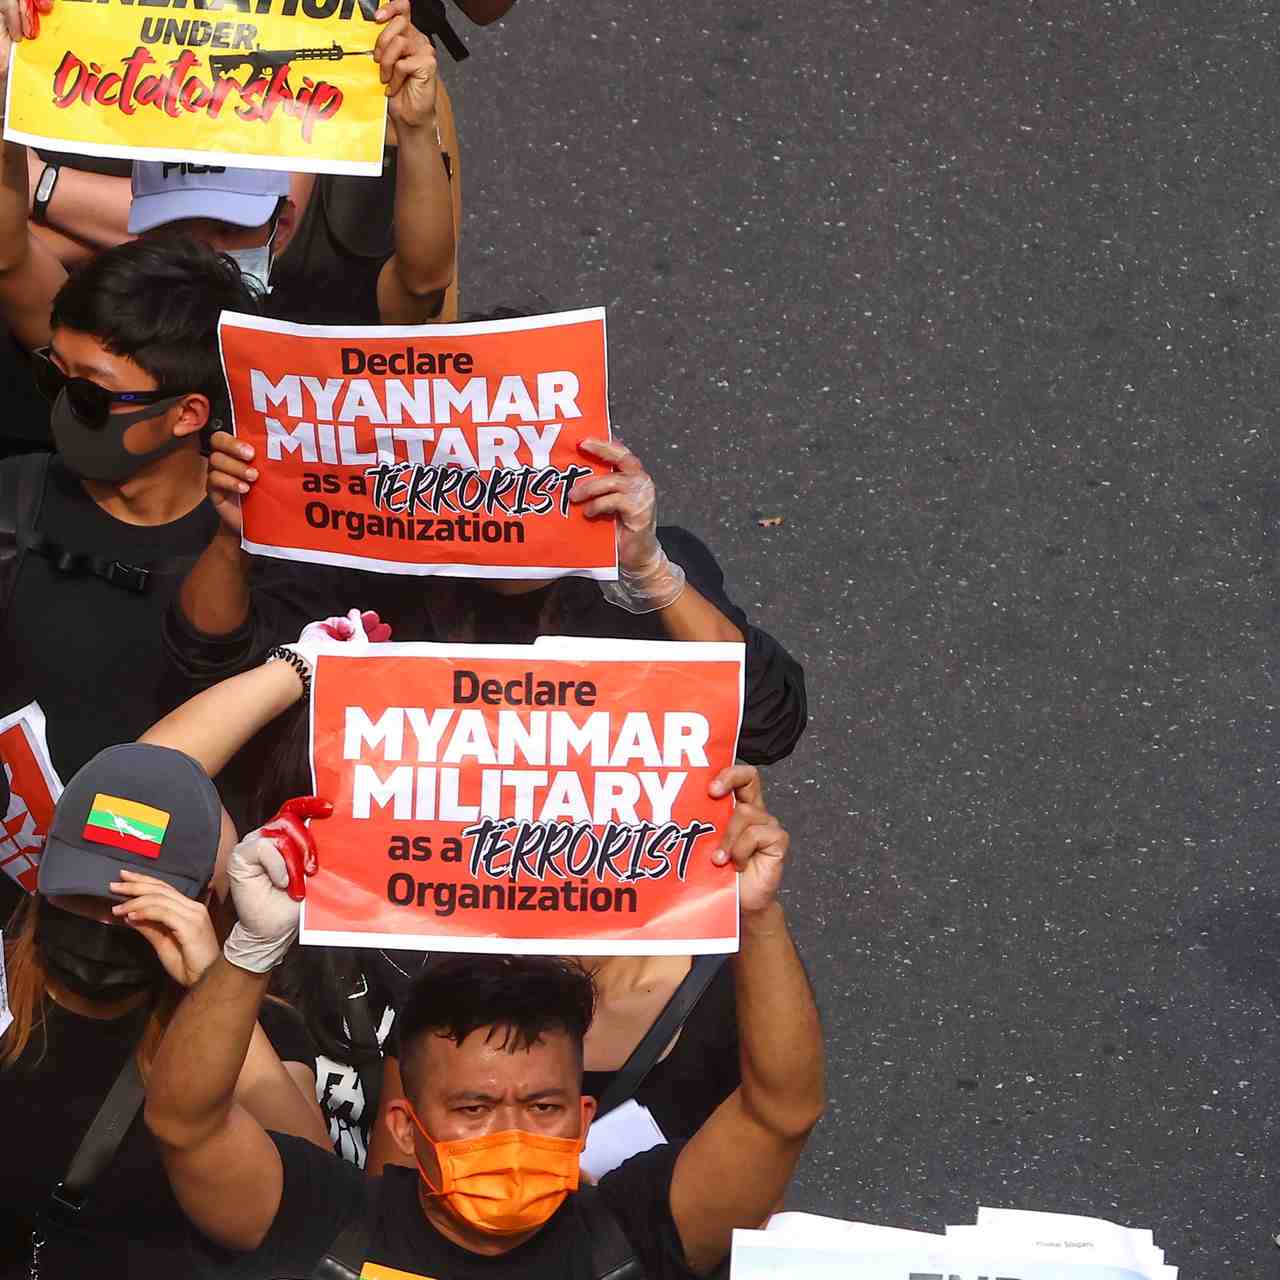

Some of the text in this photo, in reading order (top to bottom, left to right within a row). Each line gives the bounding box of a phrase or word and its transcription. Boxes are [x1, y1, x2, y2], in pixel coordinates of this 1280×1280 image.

[140, 16, 258, 50] UNDER
[52, 46, 344, 145] Dictatorship
[341, 347, 472, 375] Declare
[250, 368, 582, 424] MYANMAR
[265, 417, 562, 471] MILITARY
[303, 462, 592, 518] as a TERRORIST
[306, 501, 524, 543] Organization
[453, 670, 596, 706] Declare
[343, 706, 710, 767] MYANMAR
[352, 765, 687, 825] MILITARY
[388, 819, 714, 883] as a TERRORIST
[387, 873, 637, 916] Organization
